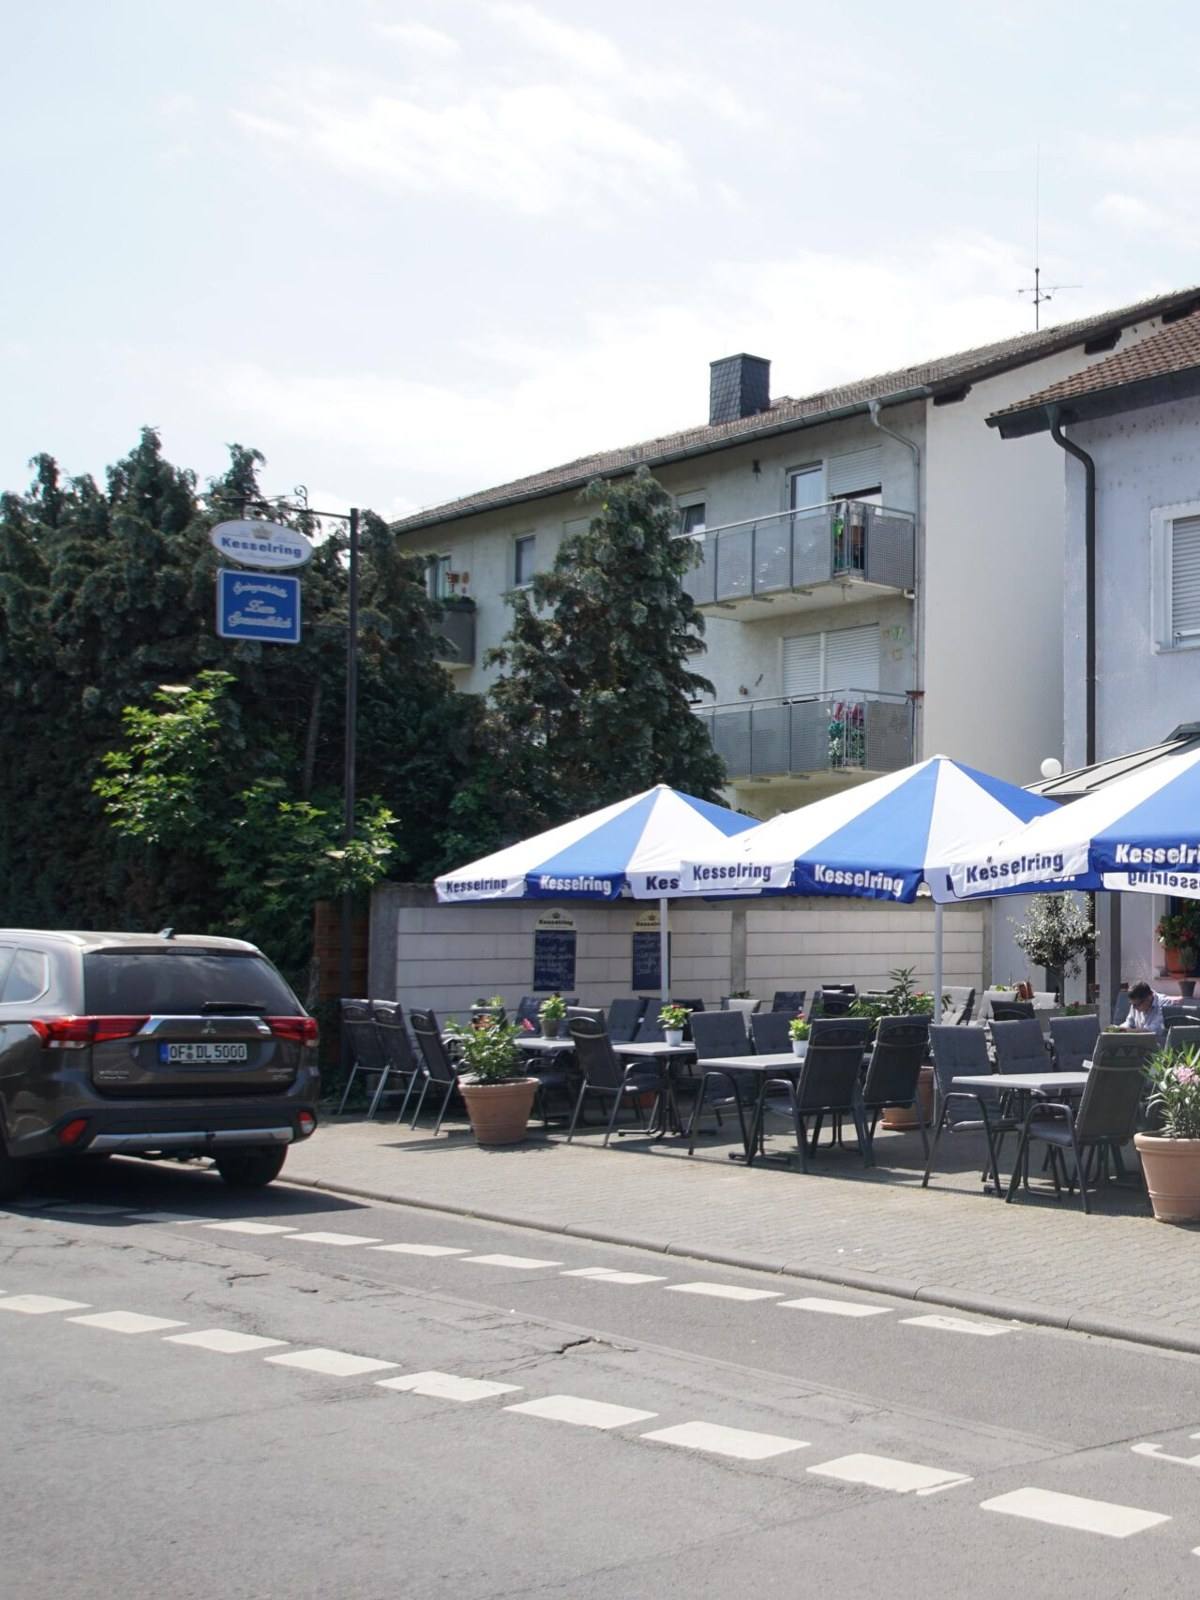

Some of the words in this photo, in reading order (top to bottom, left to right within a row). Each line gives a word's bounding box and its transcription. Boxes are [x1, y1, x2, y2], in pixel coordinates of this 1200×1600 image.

[221, 536, 302, 558] Kesselring
[693, 863, 772, 882] Kesselring
[966, 853, 1064, 883] Kesselring
[446, 877, 508, 893] Kesselring
[540, 875, 612, 896] Kesselring
[814, 864, 904, 897] Kesselring
[170, 1046, 185, 1059] OF
[196, 1046, 212, 1058] DL
[214, 1045, 246, 1059] 5000
